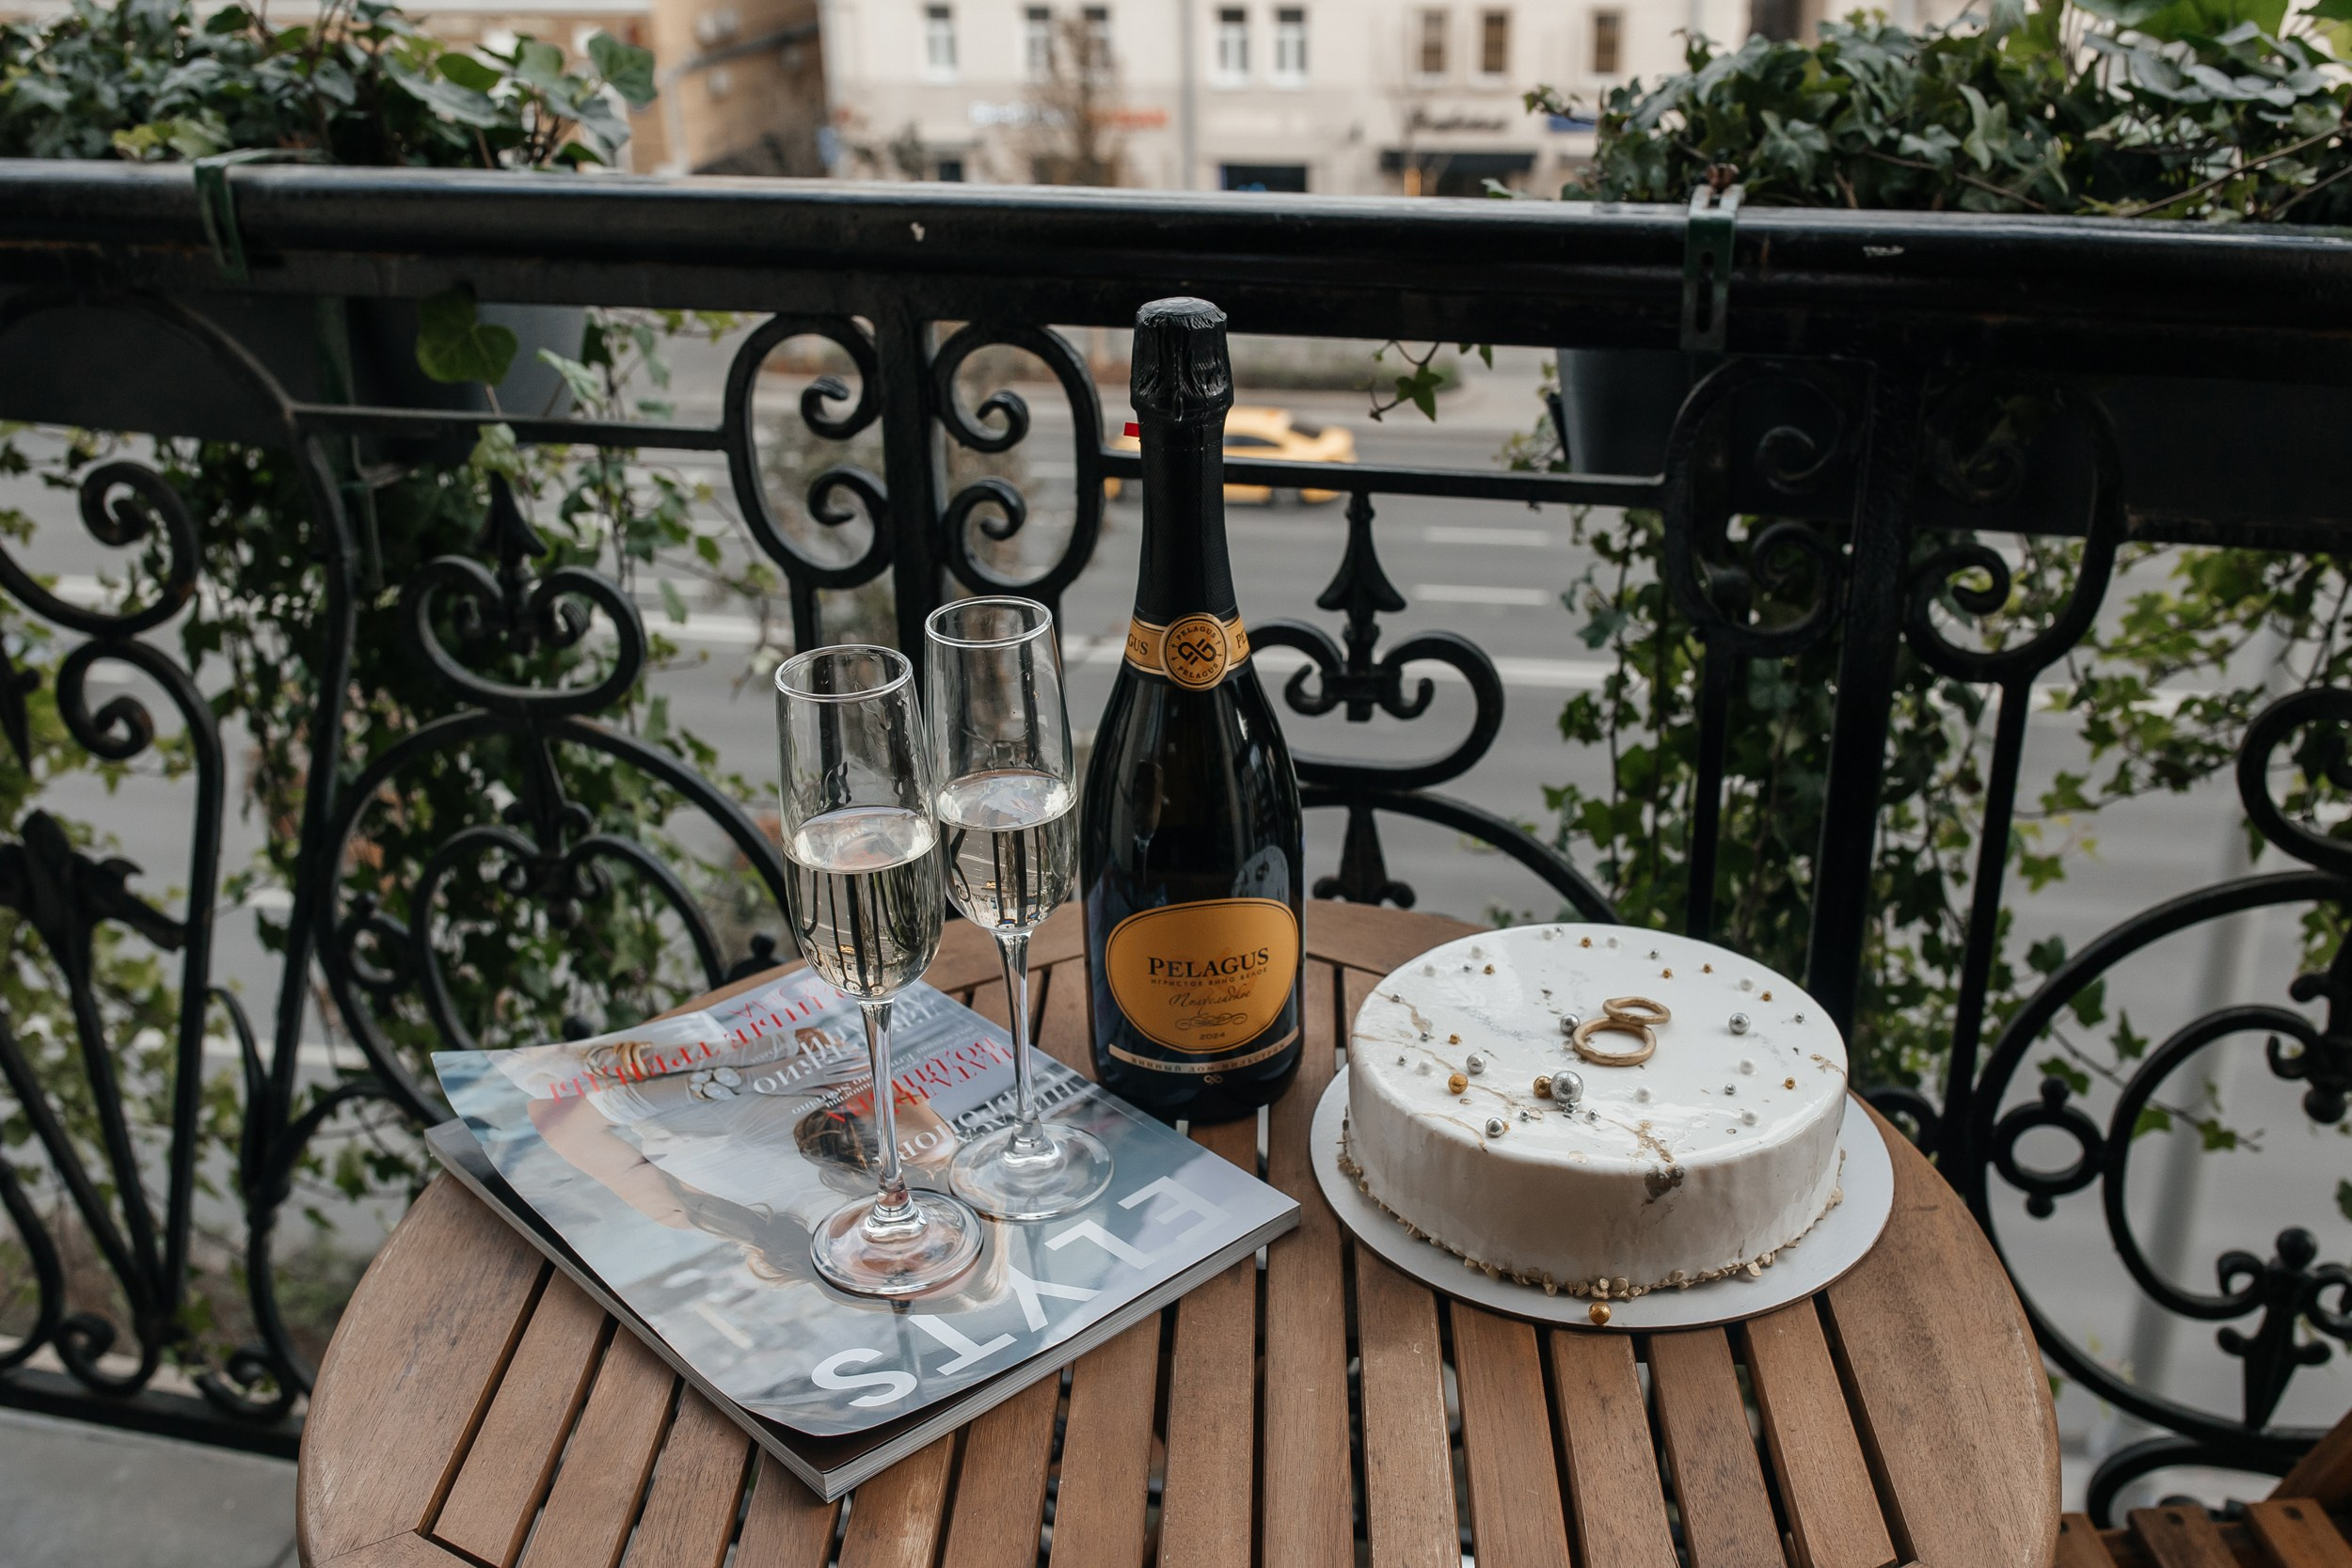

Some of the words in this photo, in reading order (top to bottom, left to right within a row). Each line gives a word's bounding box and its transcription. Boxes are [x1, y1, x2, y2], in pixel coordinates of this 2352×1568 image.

[1176, 626, 1216, 641] PELAGUS
[1177, 662, 1218, 679] PELAGUS
[1147, 947, 1269, 978] PELAGUS
[1151, 977, 1203, 988] ИГРИСТОЕ
[1208, 976, 1235, 987] ВИНО
[1240, 967, 1268, 981] БЕЛОЕ
[1199, 1031, 1226, 1040] 2024
[548, 1041, 720, 1104] ТРЕНДЫ
[1131, 1057, 1182, 1072] ВИННЫЙ
[1188, 1065, 1215, 1073] ДОМ
[811, 1175, 1232, 1407] ELYTS
